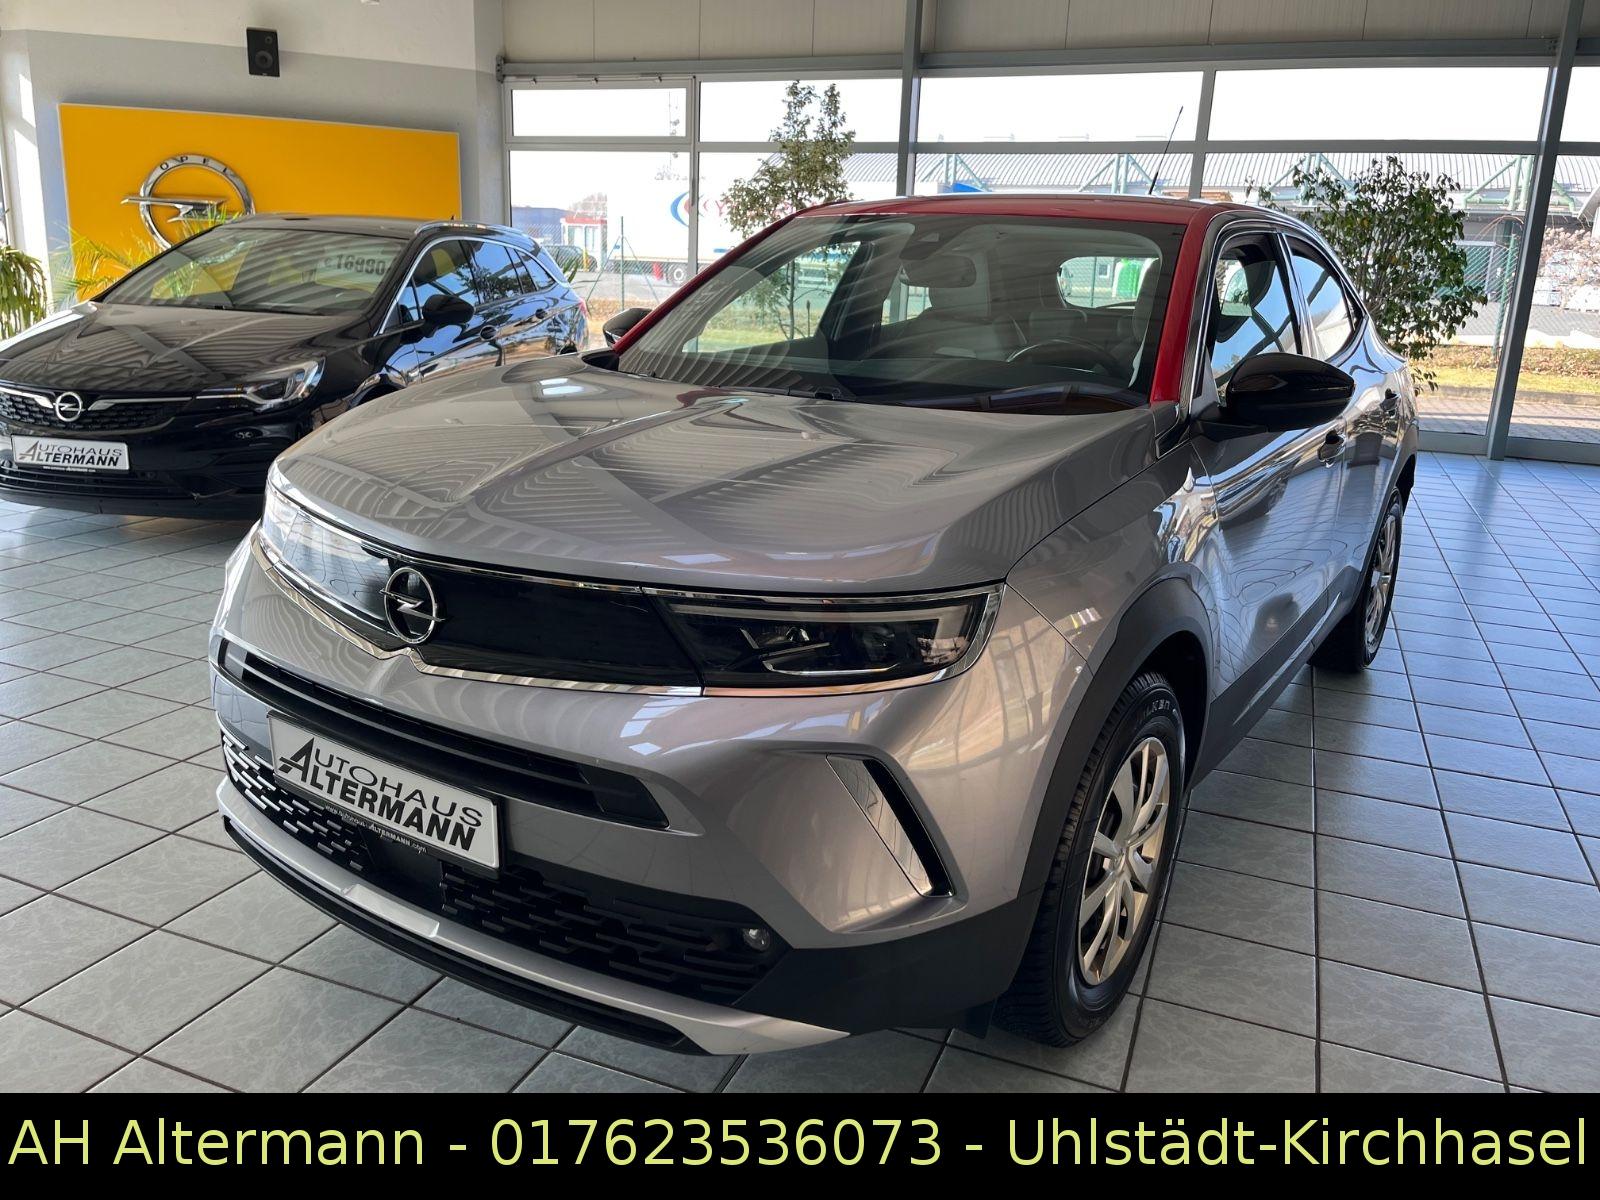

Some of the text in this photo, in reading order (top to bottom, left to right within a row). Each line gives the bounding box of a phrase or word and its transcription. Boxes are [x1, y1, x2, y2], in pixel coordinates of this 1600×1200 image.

[19, 440, 123, 461] AUTOHAUS
[19, 440, 120, 467] ALTERMANN
[278, 736, 483, 828] AUTOHAUS
[278, 736, 476, 852] ALTERMANN
